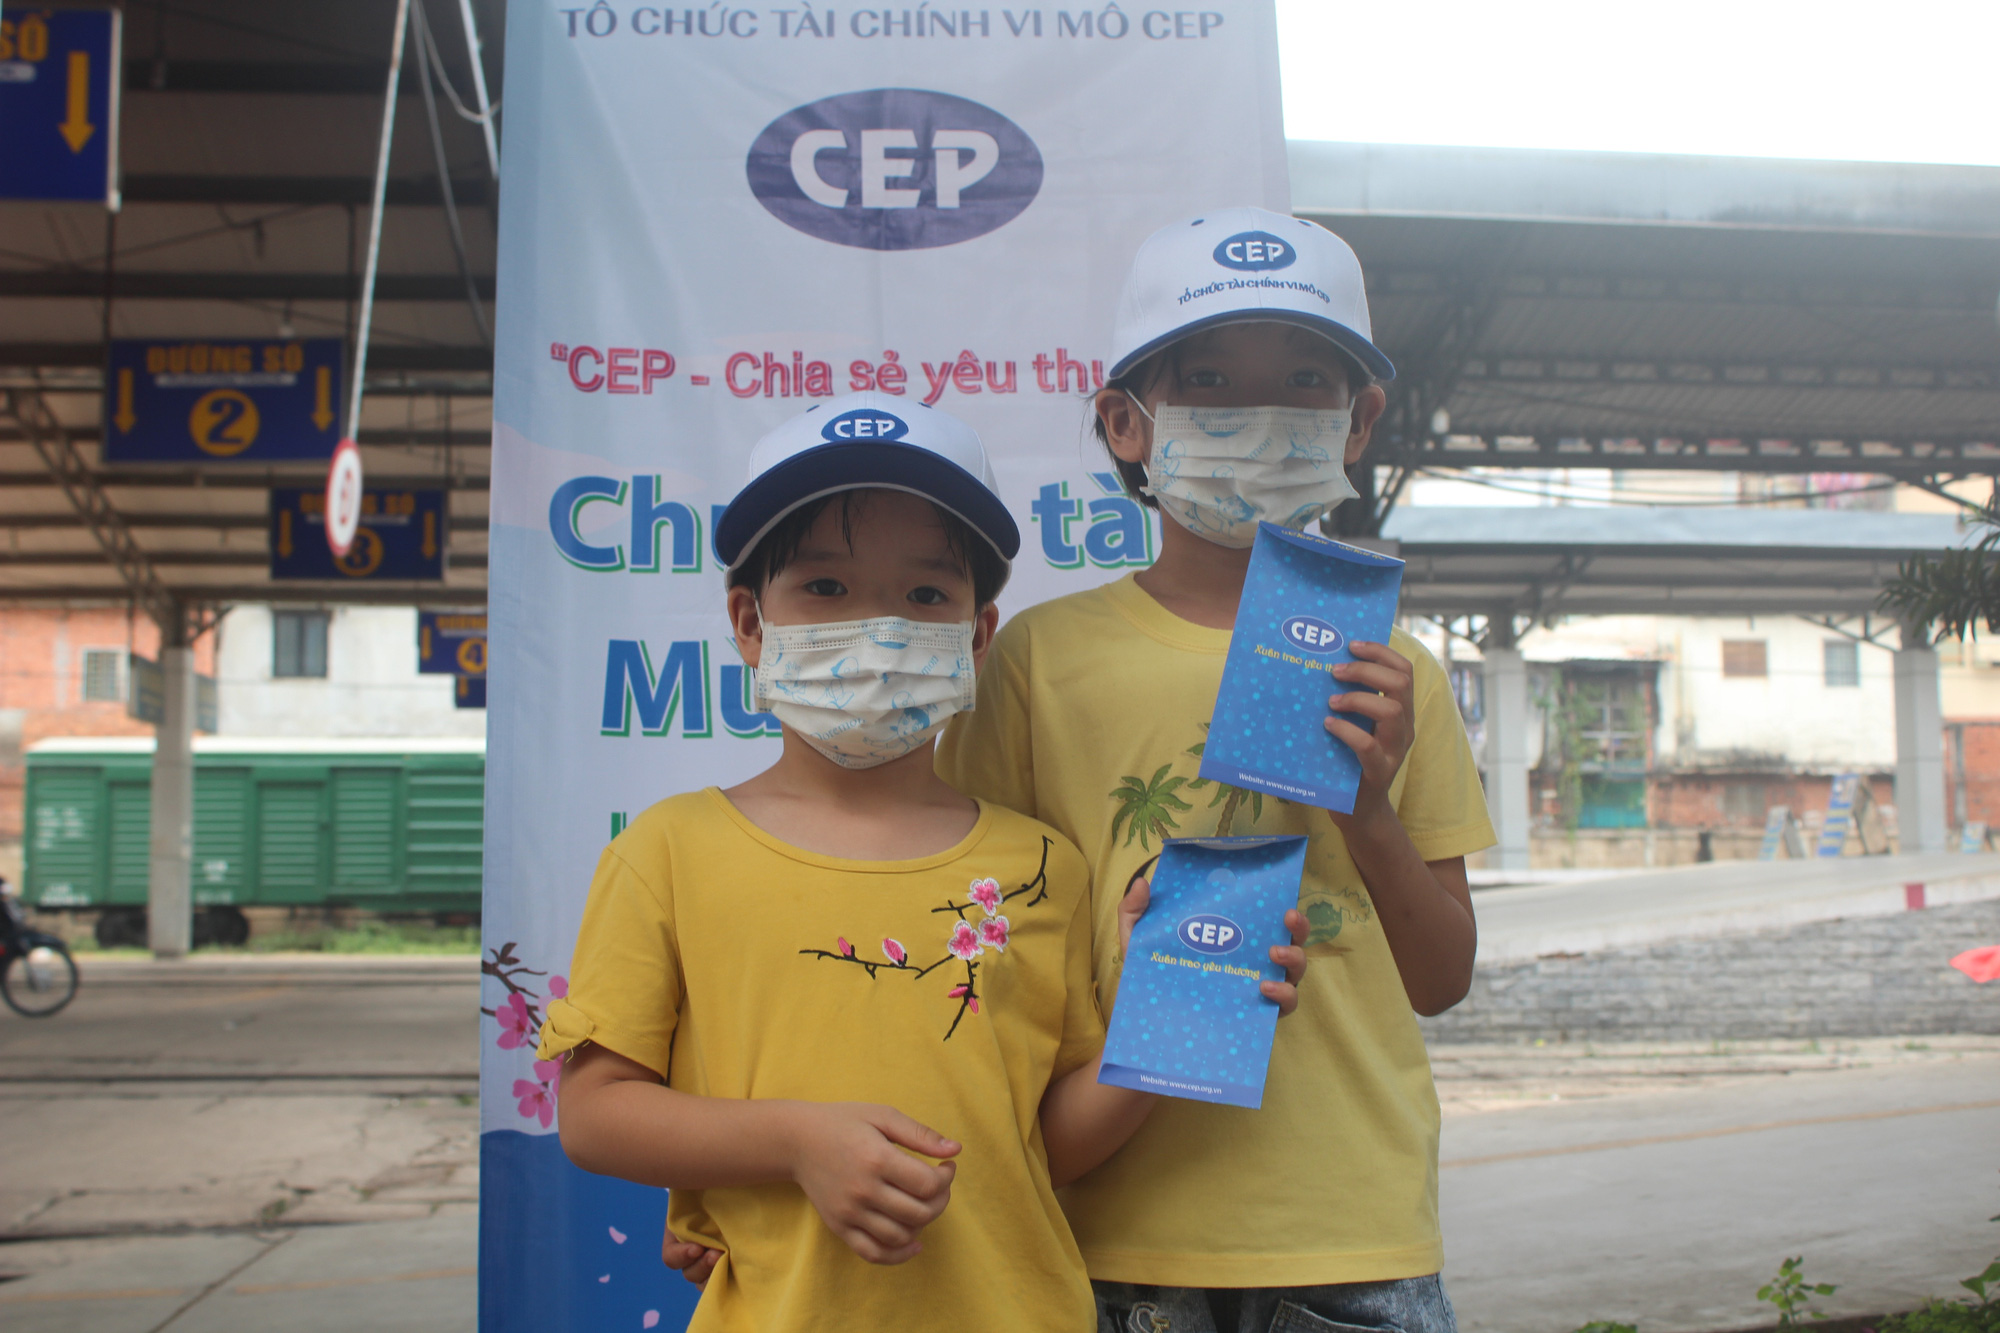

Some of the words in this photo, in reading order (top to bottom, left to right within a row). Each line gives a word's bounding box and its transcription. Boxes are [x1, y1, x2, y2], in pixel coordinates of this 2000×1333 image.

[631, 1, 759, 38] CHỨC
[770, 3, 836, 38] TÀI
[850, 1, 990, 39] CHÍNH
[1002, 9, 1043, 38] VI
[1057, 1, 1130, 39] MÔ
[1142, 10, 1225, 40] CEP
[790, 129, 1000, 209] CEP
[1225, 241, 1285, 262] CEP
[1226, 278, 1245, 290] TÀI
[1246, 276, 1285, 289] CHÍNH
[1285, 280, 1298, 290] VI
[1299, 283, 1317, 295] MÔ
[725, 350, 834, 399] Chia
[849, 350, 908, 396] sẻ
[920, 349, 1018, 406] yêu
[207, 399, 246, 445] 2
[834, 418, 896, 438] CEP
[549, 474, 726, 574] Ch
[1031, 471, 1163, 570] tà
[1291, 621, 1336, 647] CEP
[1254, 644, 1280, 660] Xuân
[1282, 652, 1303, 665] trao
[1304, 659, 1323, 671] yêu
[1238, 772, 1266, 786] Website:
[1266, 780, 1316, 798] www.cep.org.vn
[1187, 921, 1235, 946] CEP
[1151, 952, 1178, 966] Xuân
[1179, 957, 1201, 969] trao
[1203, 961, 1222, 973] yêu
[1140, 1074, 1168, 1087] Website:
[1169, 1081, 1223, 1095] www.cep.org.vn
